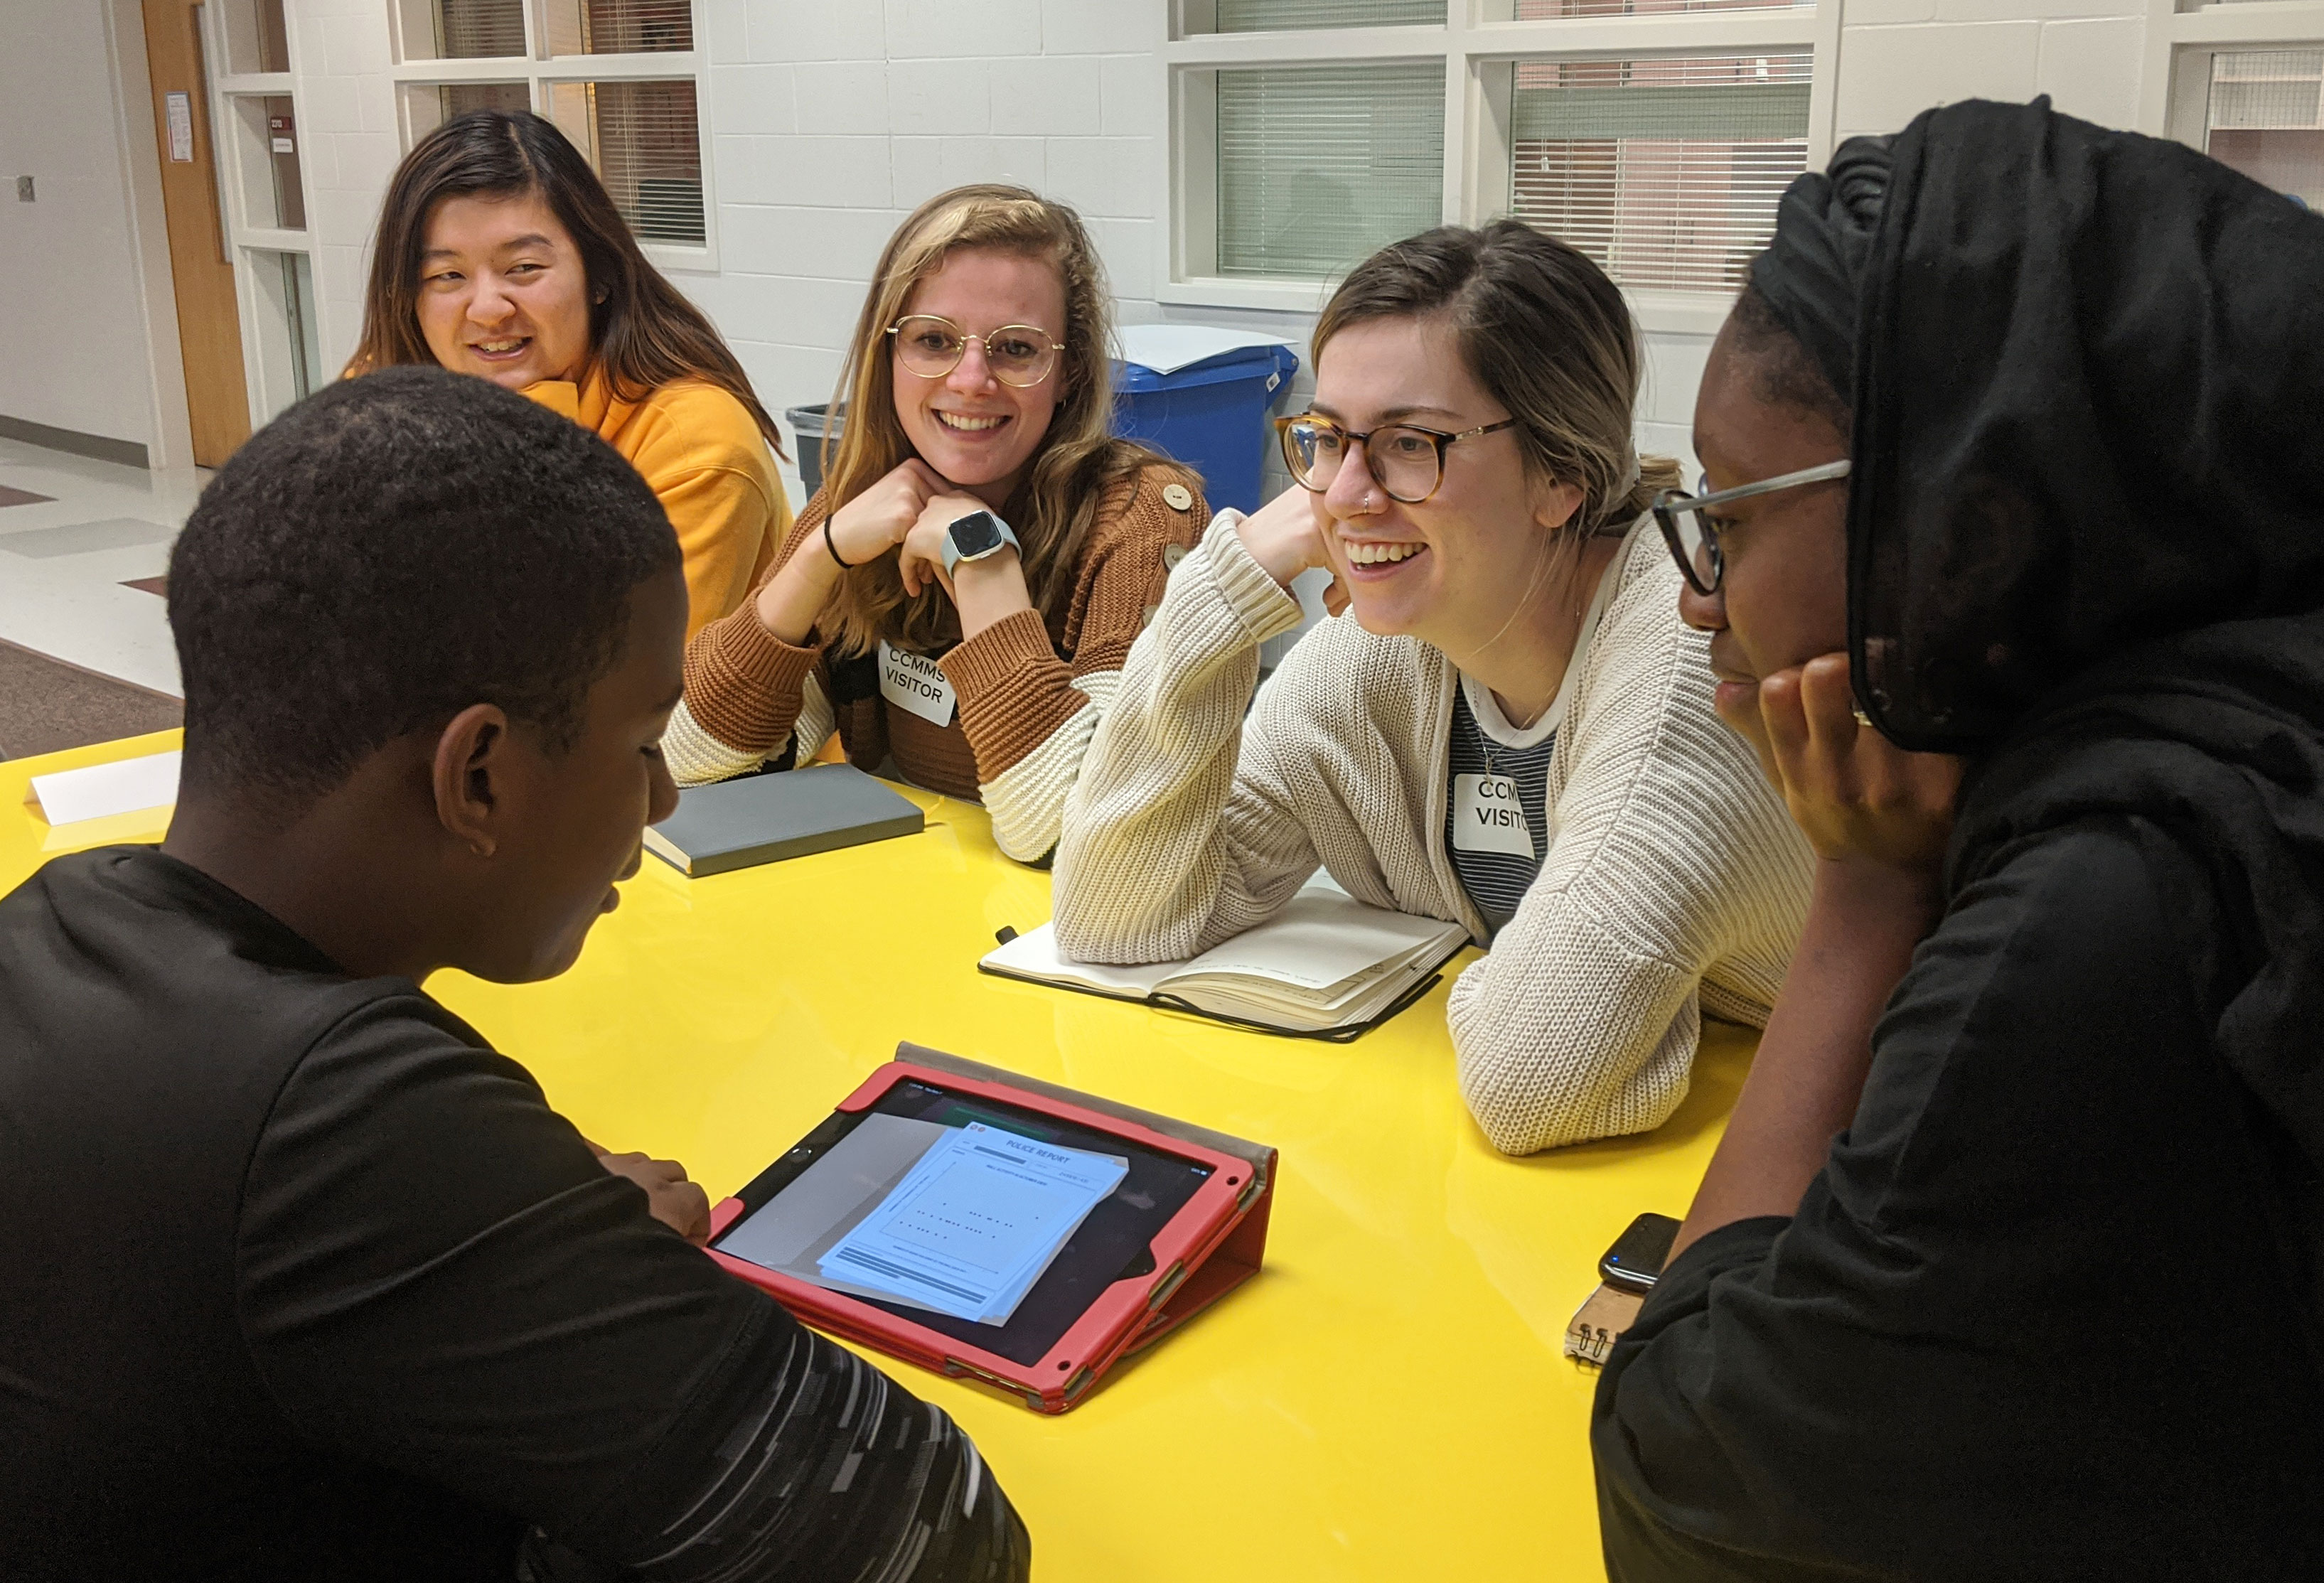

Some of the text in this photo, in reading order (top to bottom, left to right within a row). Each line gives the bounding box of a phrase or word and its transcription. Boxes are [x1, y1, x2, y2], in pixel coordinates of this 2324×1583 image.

[889, 648, 946, 682] CCMMS
[886, 665, 943, 704] VISITOR
[1006, 1139, 1071, 1164] POLICE REPORT
